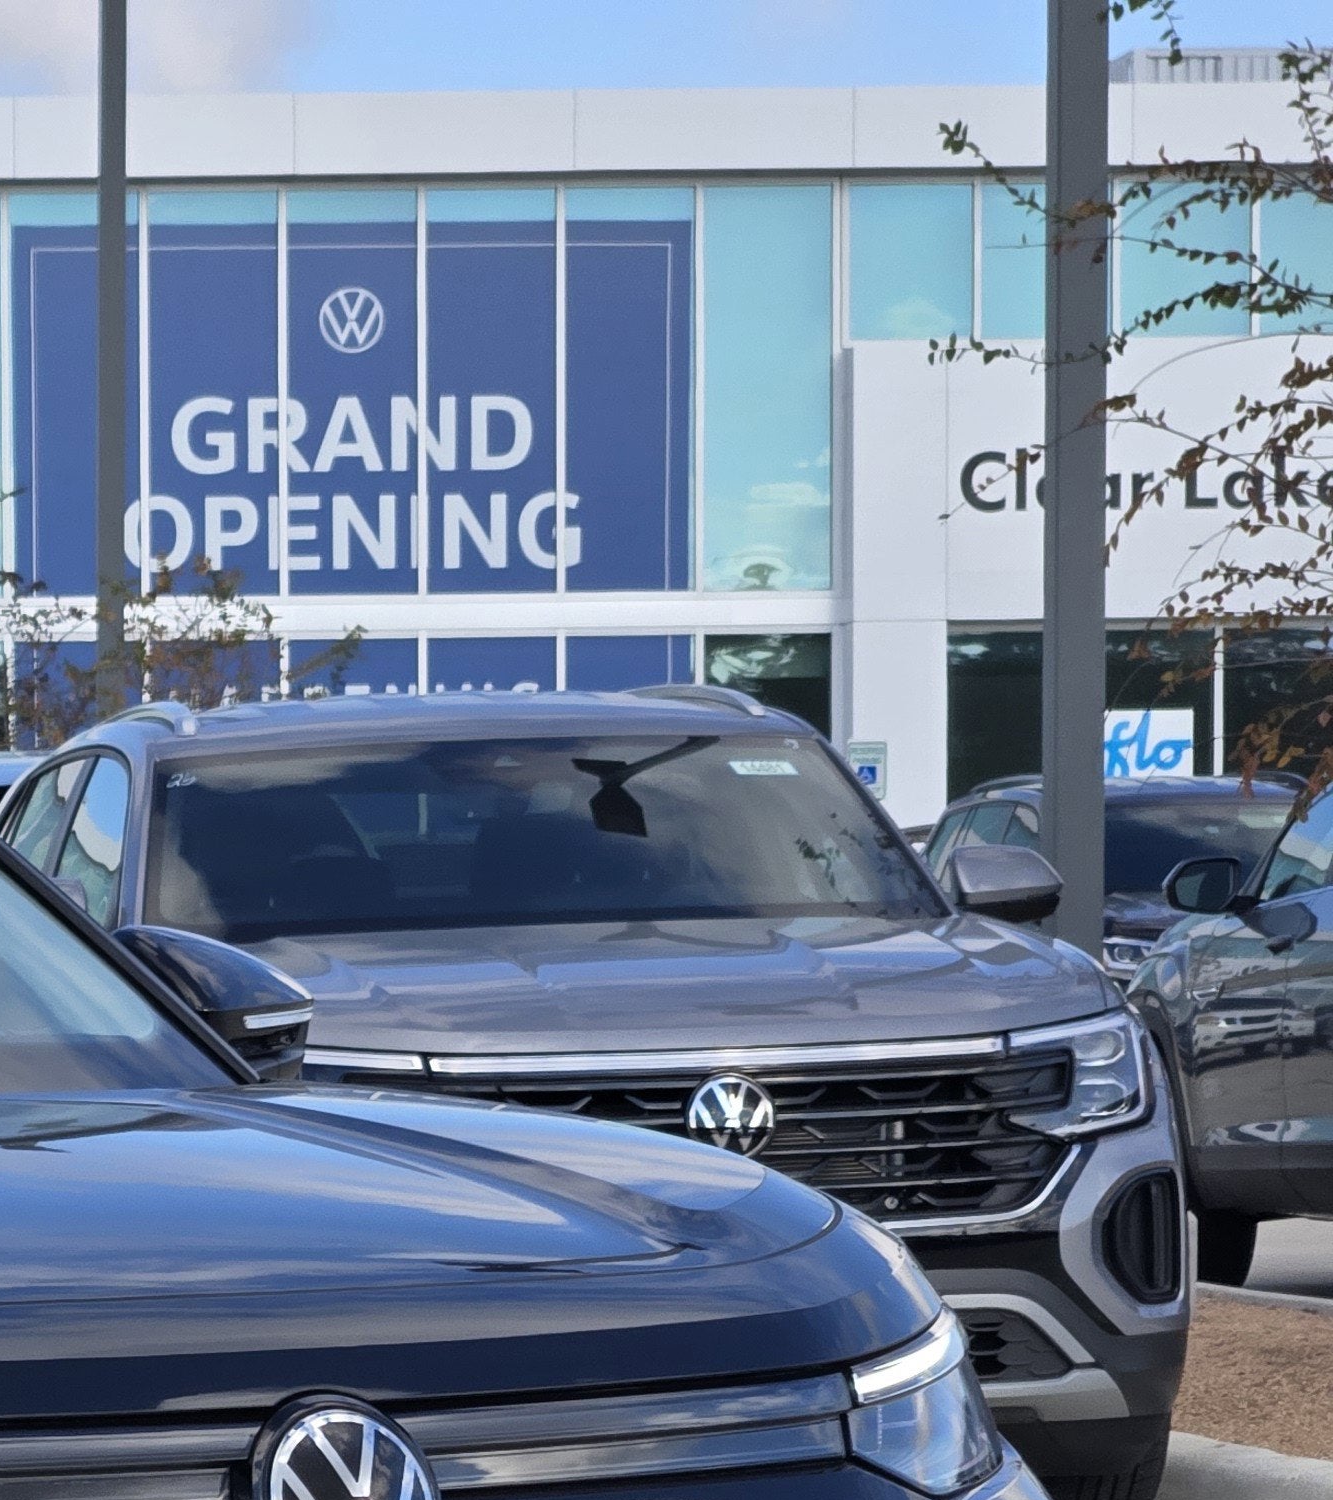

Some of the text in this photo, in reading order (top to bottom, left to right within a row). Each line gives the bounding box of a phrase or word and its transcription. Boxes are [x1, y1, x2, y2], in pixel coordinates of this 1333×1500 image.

[319, 287, 383, 353] VW
[171, 395, 534, 475] GRAND
[960, 447, 1154, 512] Clr
[123, 491, 583, 574] OPENING
